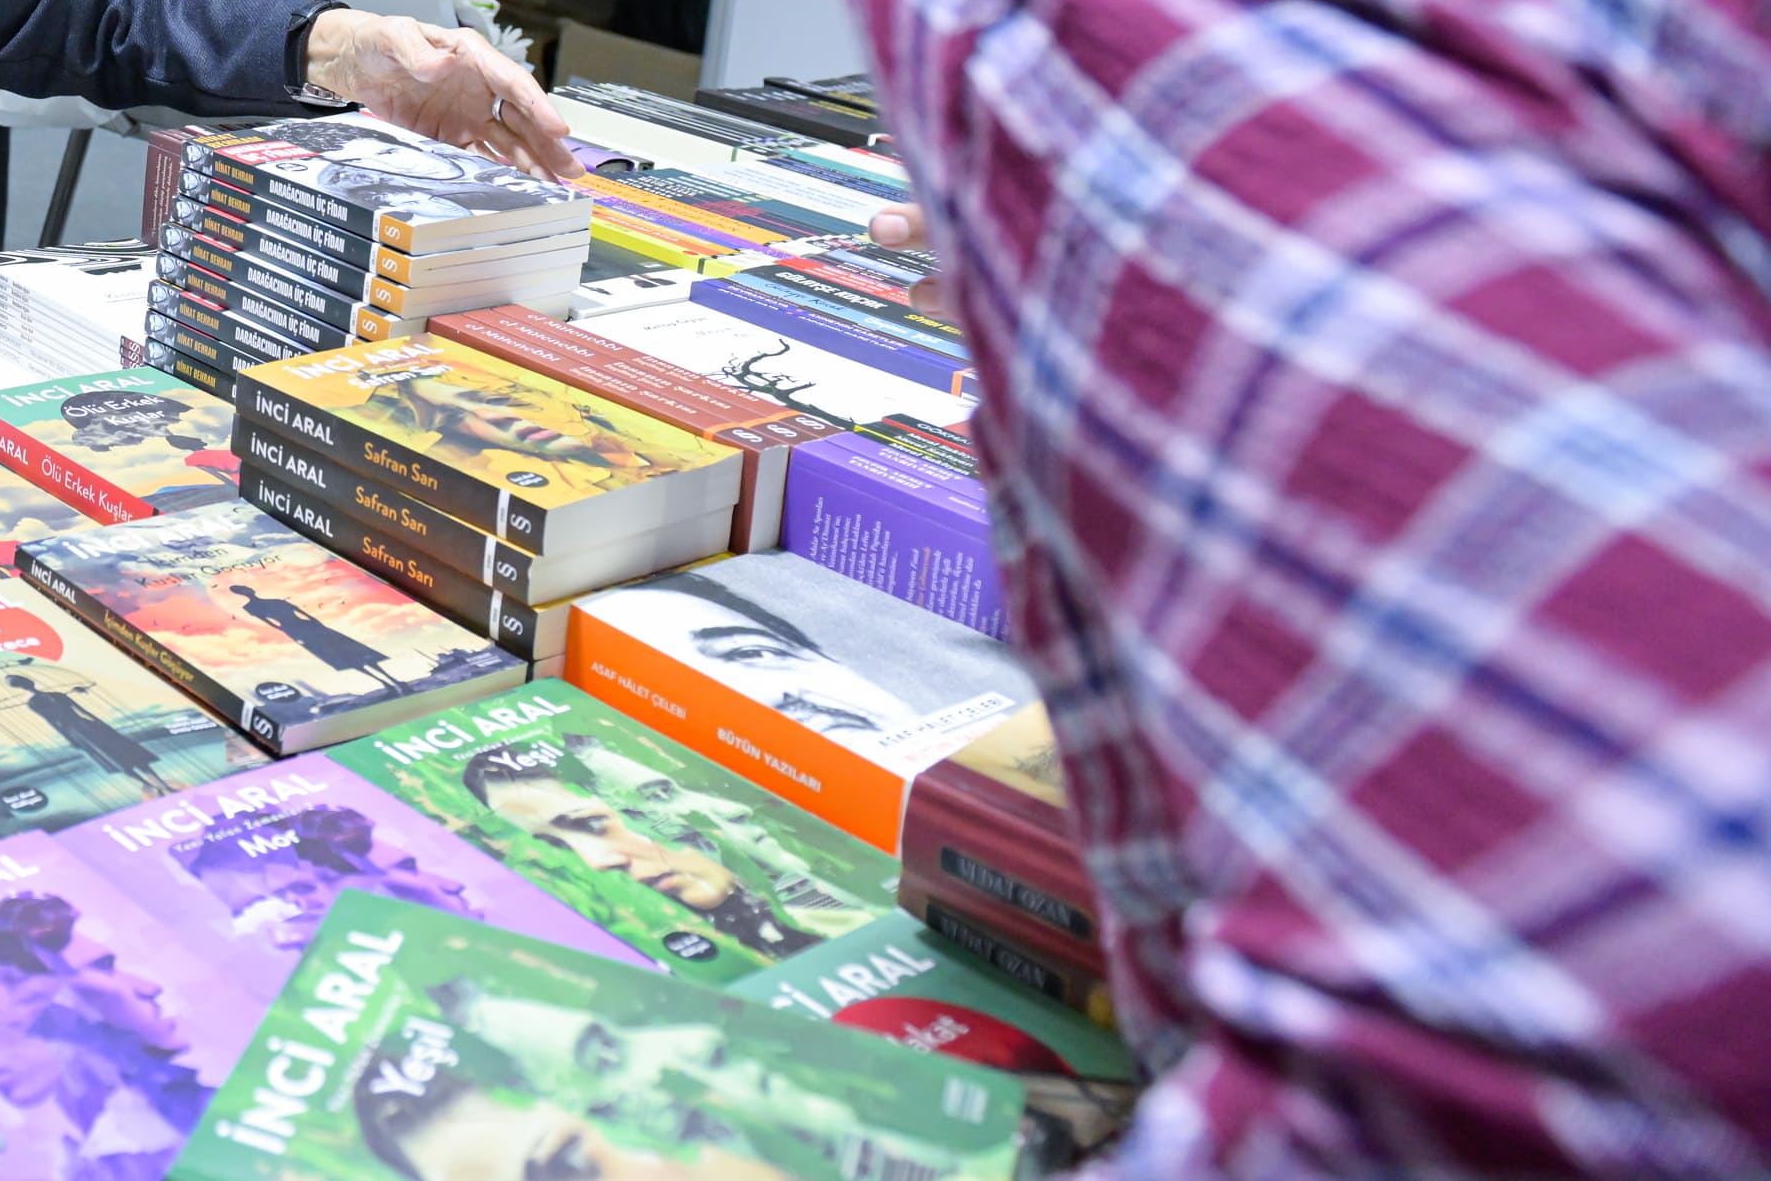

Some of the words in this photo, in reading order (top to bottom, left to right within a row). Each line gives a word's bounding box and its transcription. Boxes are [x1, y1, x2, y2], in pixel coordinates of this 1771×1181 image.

[0, 383, 72, 408] İNCİ
[78, 375, 155, 397] ARAL
[283, 353, 363, 380] İNCİ
[364, 343, 445, 366] ARAL
[64, 401, 105, 418] Ölü
[110, 394, 164, 411] Erkek
[103, 410, 165, 428] Kuşlar
[256, 390, 291, 424] İNCİ
[292, 412, 334, 445] ARAL
[364, 442, 407, 477] Safran
[411, 465, 439, 491] Sarı
[41, 454, 62, 483] Ölü
[64, 470, 96, 504] Erkek
[98, 489, 133, 523] Kuşlar
[251, 432, 284, 466] İNCİ
[285, 454, 327, 489] ARAL
[355, 486, 398, 521] Safran
[401, 511, 427, 536] Sarı
[62, 527, 143, 560] İNCİ
[155, 515, 247, 545] ARAL
[259, 480, 291, 515] İNCİ
[293, 505, 334, 538] ARAL
[362, 536, 405, 571] Safran
[408, 562, 434, 588] Sarı
[31, 560, 52, 587] İNCİ
[52, 578, 77, 605] ARAL
[591, 661, 618, 683] ASAF
[651, 692, 687, 720] ÇELEBİ
[374, 719, 475, 765] İNCİ
[472, 695, 572, 737] ARAL
[488, 740, 565, 771] Yeşil
[717, 727, 762, 764] BÜTÜN
[763, 750, 822, 794] YAZILARI
[103, 800, 215, 852] İNCİ
[217, 773, 328, 820] ARAL
[237, 829, 301, 858] Mor
[819, 944, 935, 1006] ARAL
[215, 1035, 336, 1155] İNCİ
[301, 930, 404, 1045] ARAL
[369, 1014, 460, 1097] Yeşil
